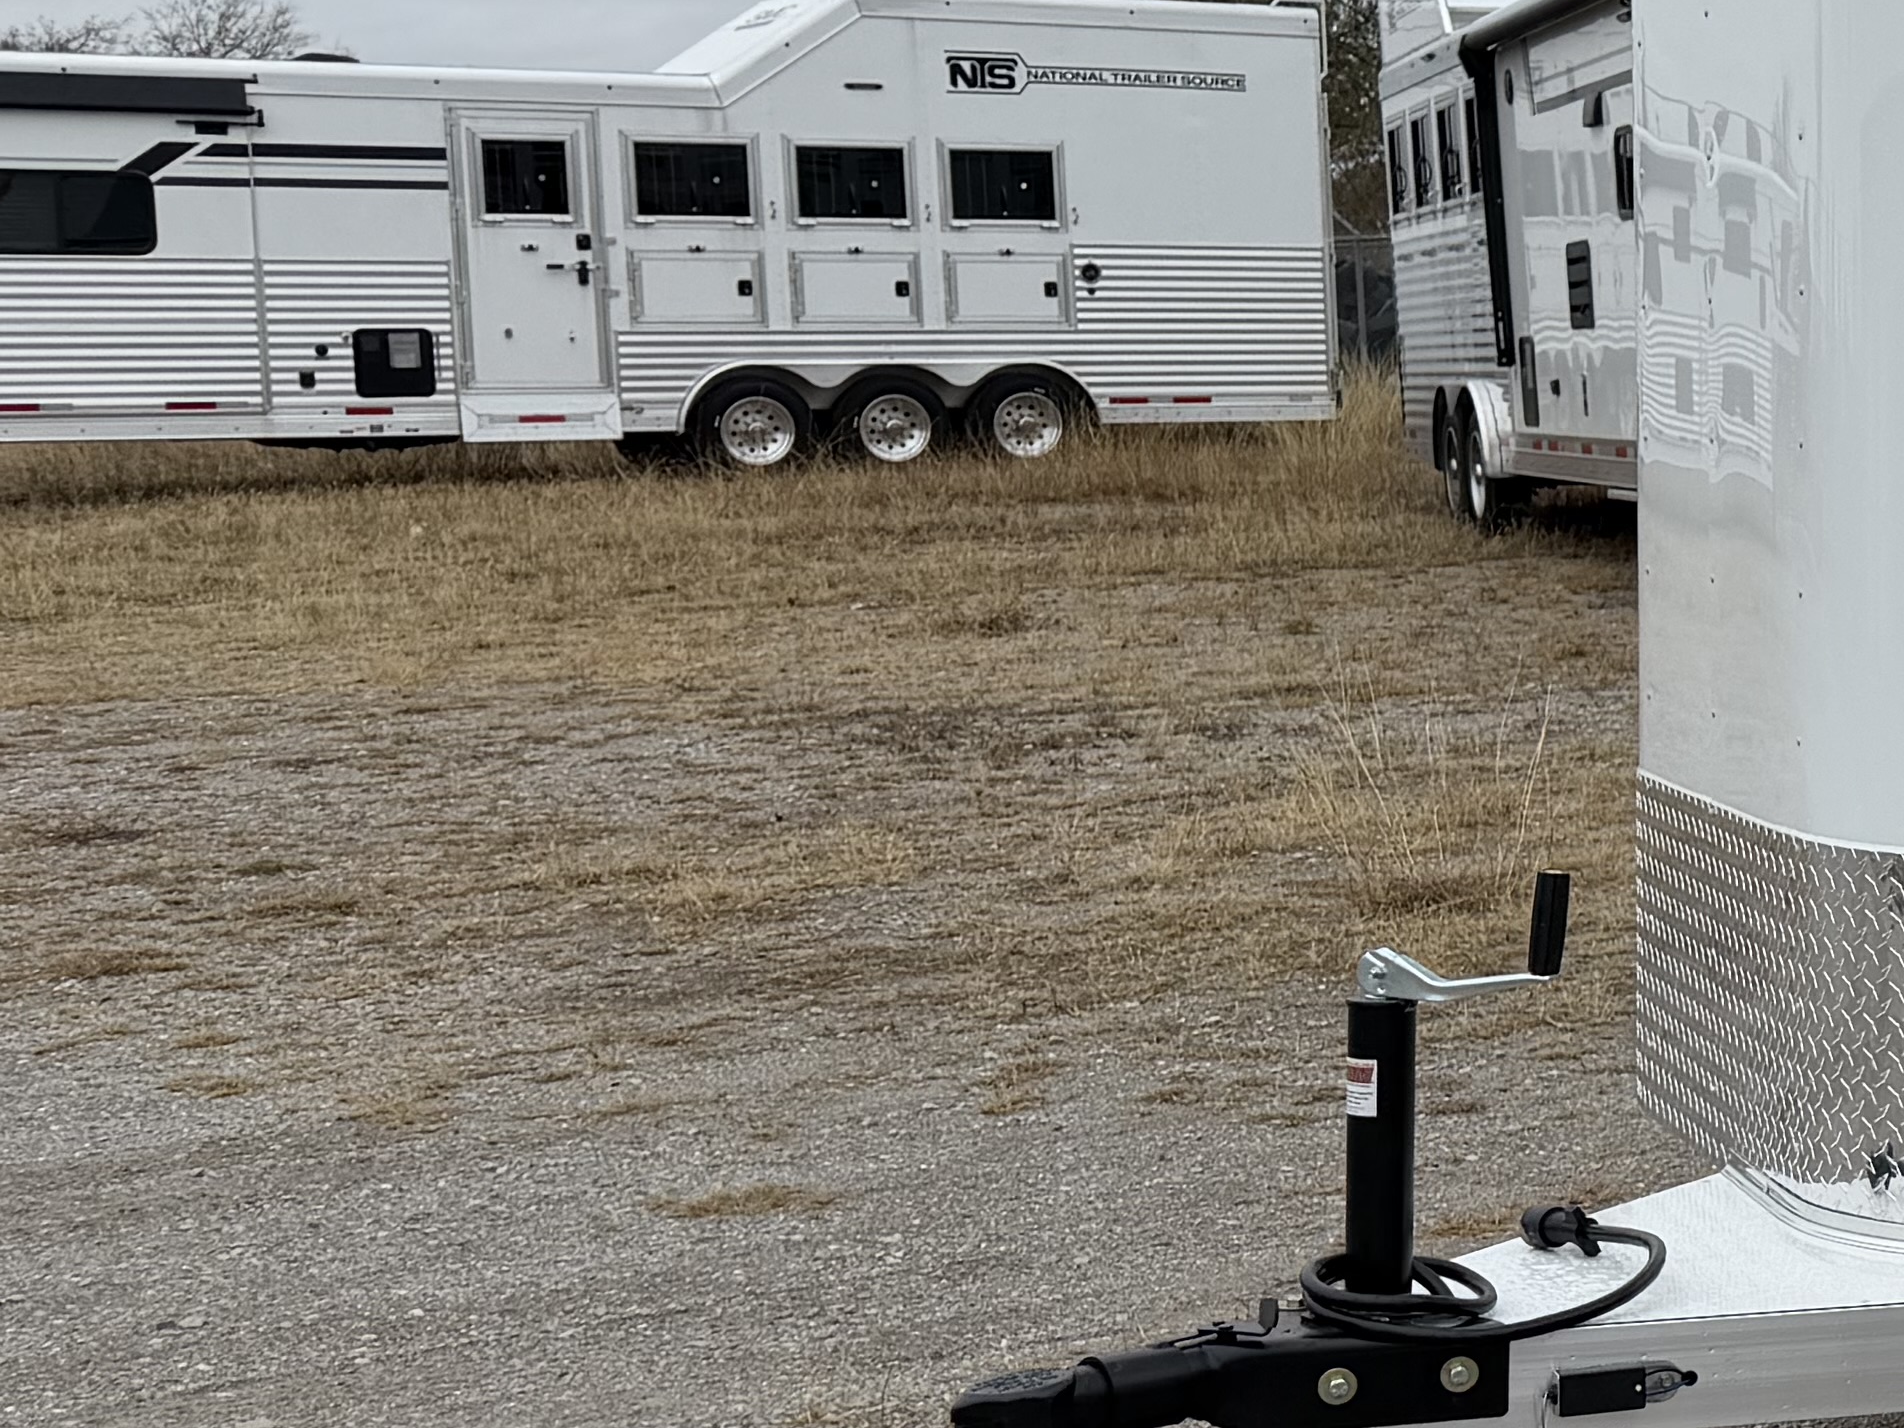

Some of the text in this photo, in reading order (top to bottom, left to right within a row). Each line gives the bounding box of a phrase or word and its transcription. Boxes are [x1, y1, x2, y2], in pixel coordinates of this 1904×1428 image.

[946, 56, 1018, 90] NTS
[1026, 69, 1247, 90] NATIONAL TRAILER SOURCE
